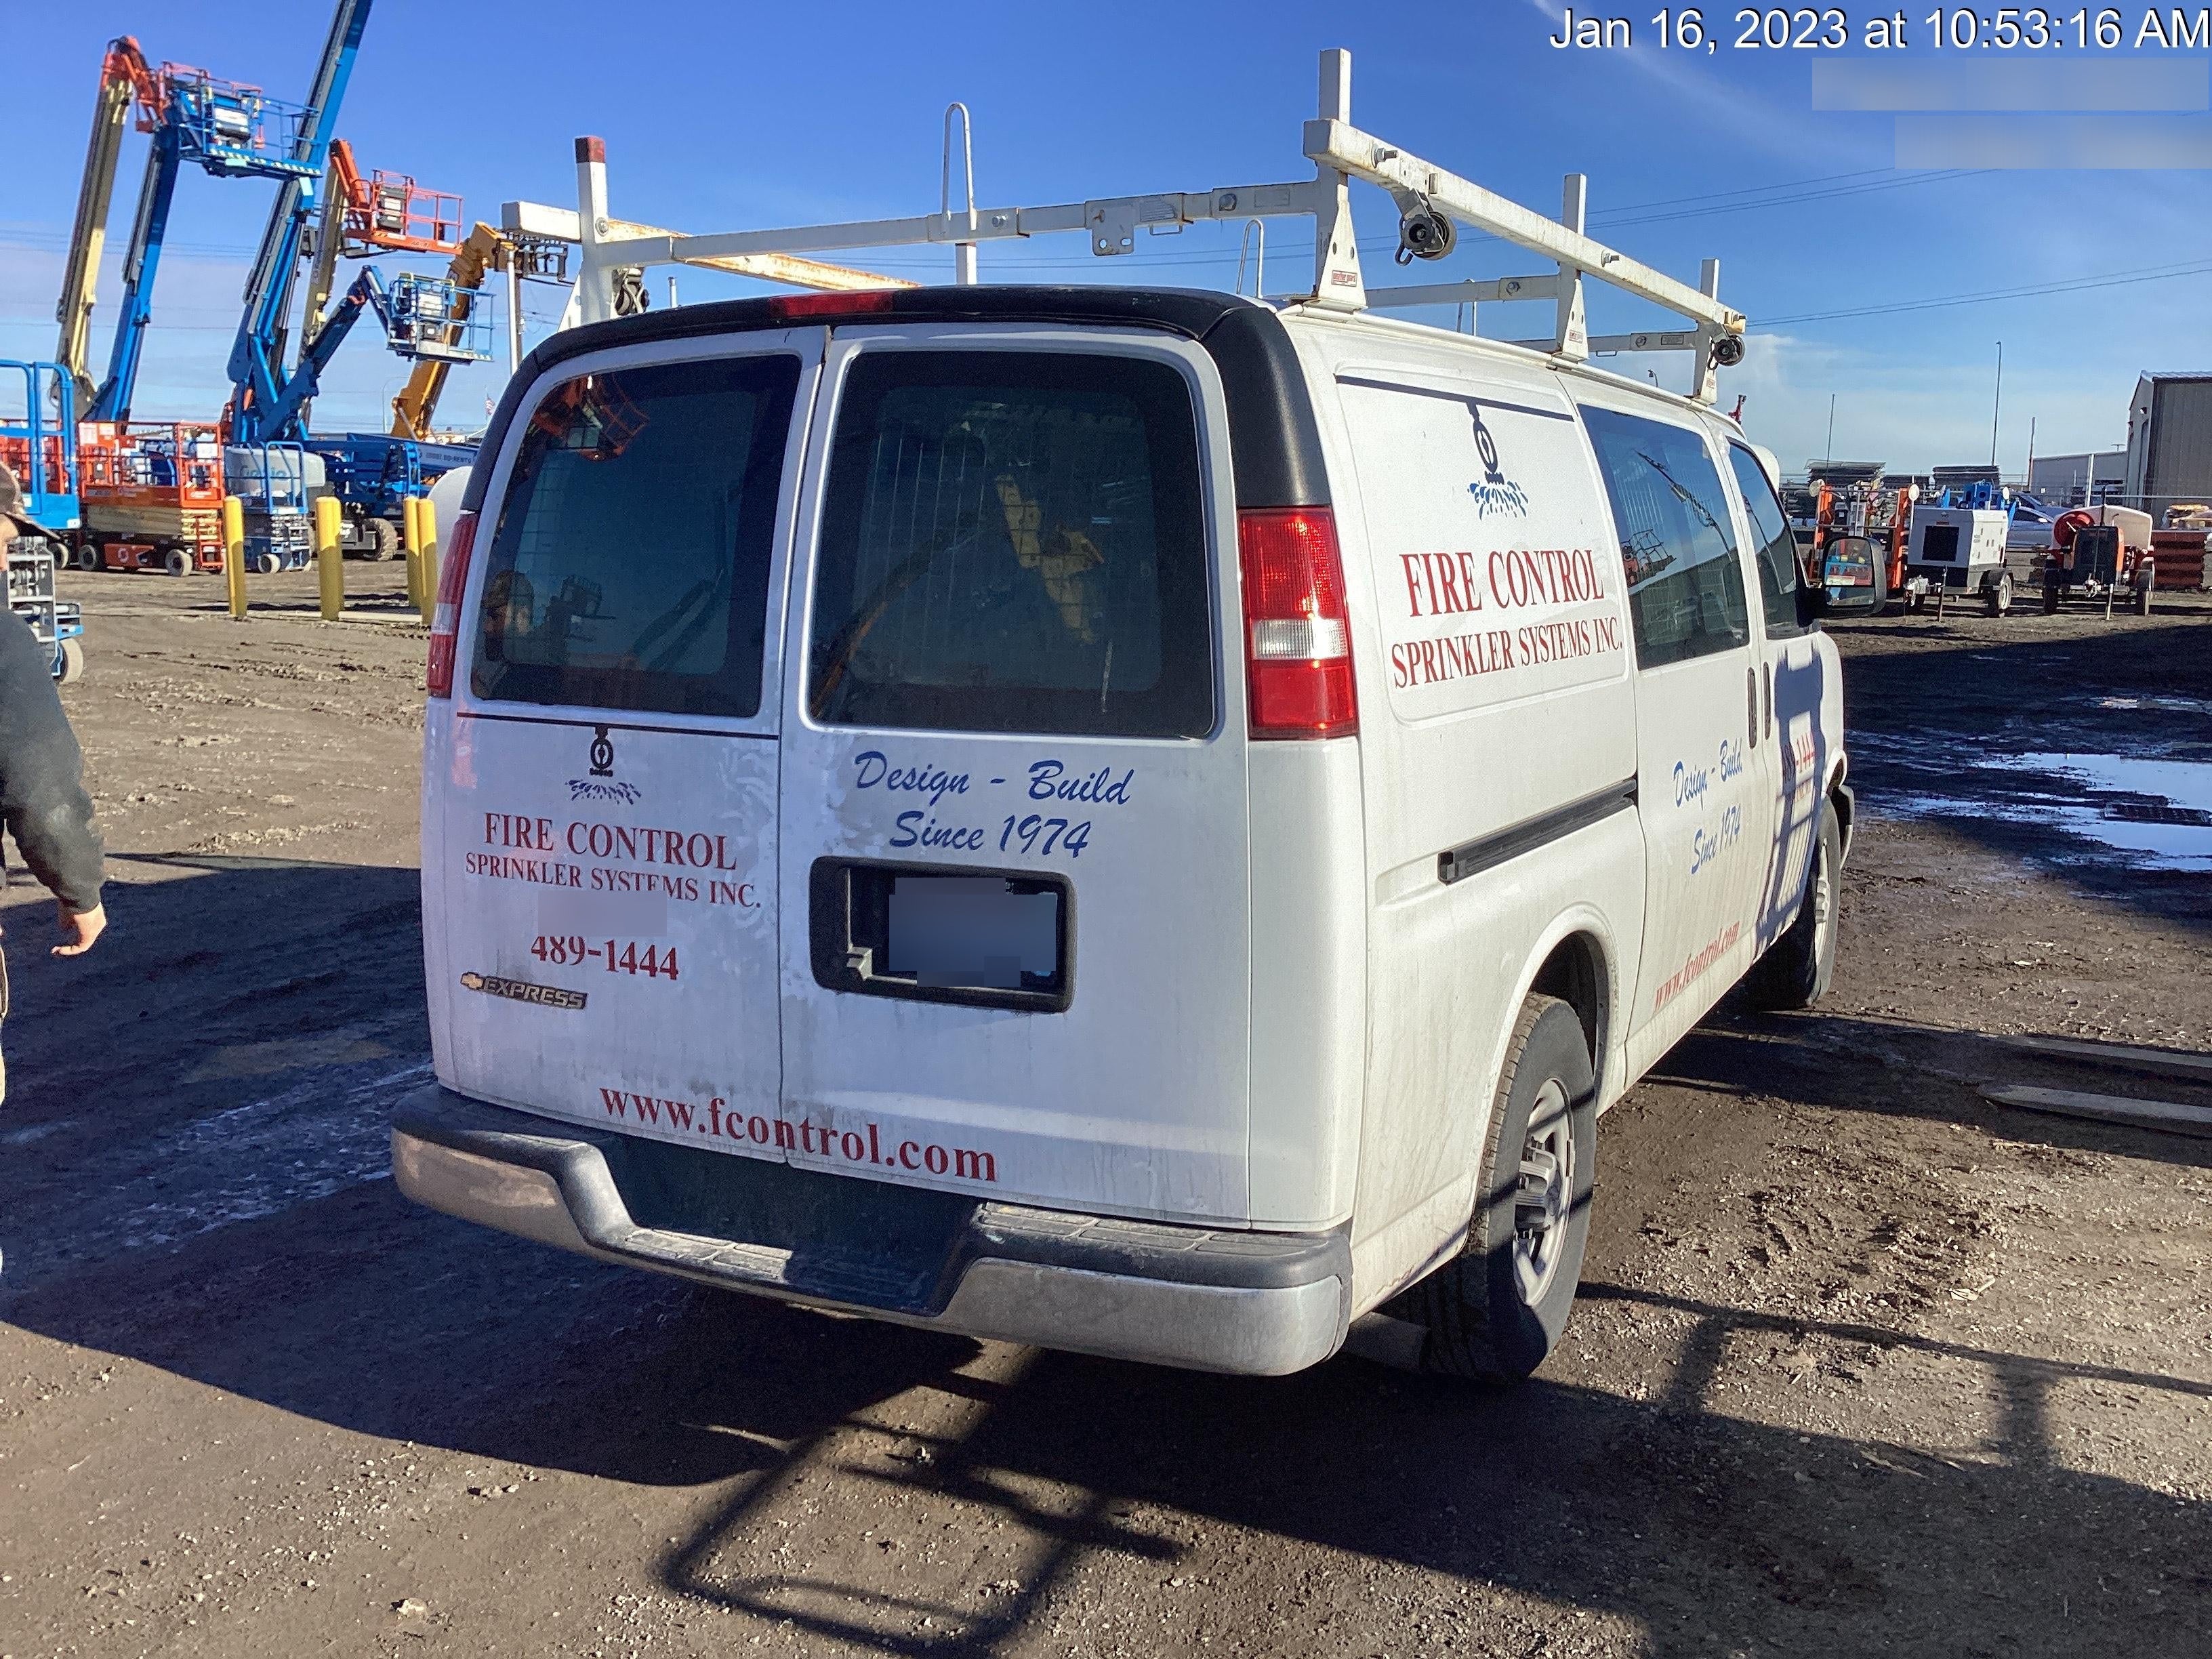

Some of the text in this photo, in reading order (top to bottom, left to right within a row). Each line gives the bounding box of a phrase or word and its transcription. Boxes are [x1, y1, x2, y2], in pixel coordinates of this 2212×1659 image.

[1399, 548, 1605, 618] FIRE CONTROL
[1391, 615, 1624, 689] SPRINKLER SYSTEMS INC.
[854, 750, 1135, 806] Design - Build
[1673, 760, 1708, 812] Design
[1719, 737, 1744, 783] Build
[484, 812, 738, 871] FIRE CONTROL
[888, 811, 1094, 859] Since 1974
[1690, 802, 1742, 876] Since 1974
[466, 851, 762, 909] SPRINKLER SYSTEMS INC.
[530, 935, 680, 981] 489-1444
[1654, 919, 1741, 1013] www.fcontrol.com
[483, 977, 584, 1010] EXPRESS
[598, 1087, 998, 1183] www.fcontrol.com
